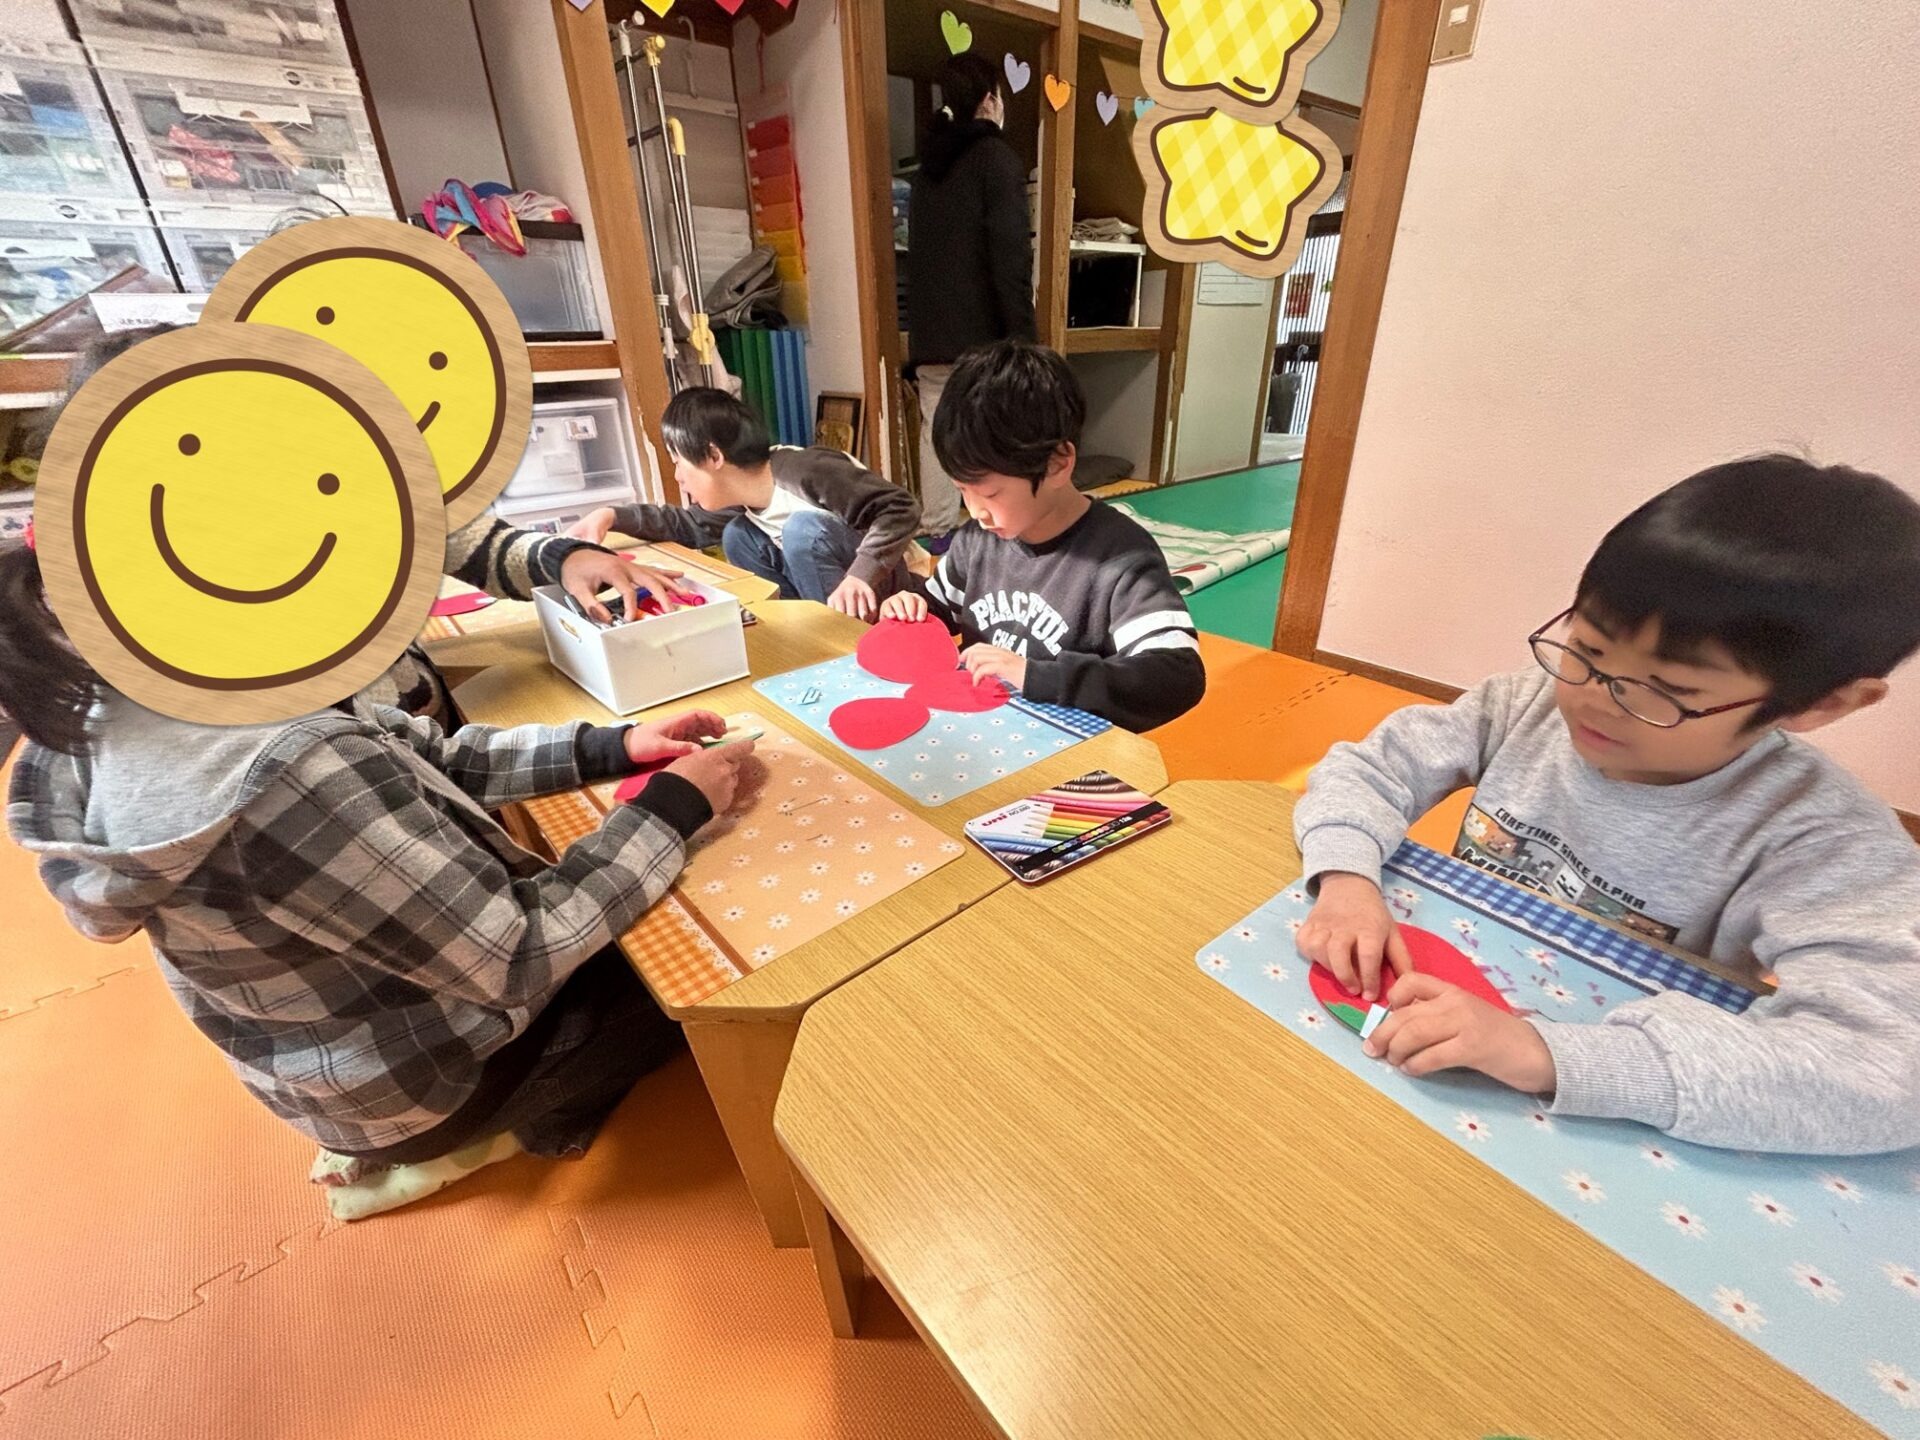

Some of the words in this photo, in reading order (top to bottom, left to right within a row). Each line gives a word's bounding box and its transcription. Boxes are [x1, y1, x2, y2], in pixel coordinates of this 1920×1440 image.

[981, 813, 1008, 827] uni
[1495, 807, 1561, 848] CRAFTING
[1560, 843, 1591, 879] SINCE
[1592, 875, 1647, 910] ALPHA
